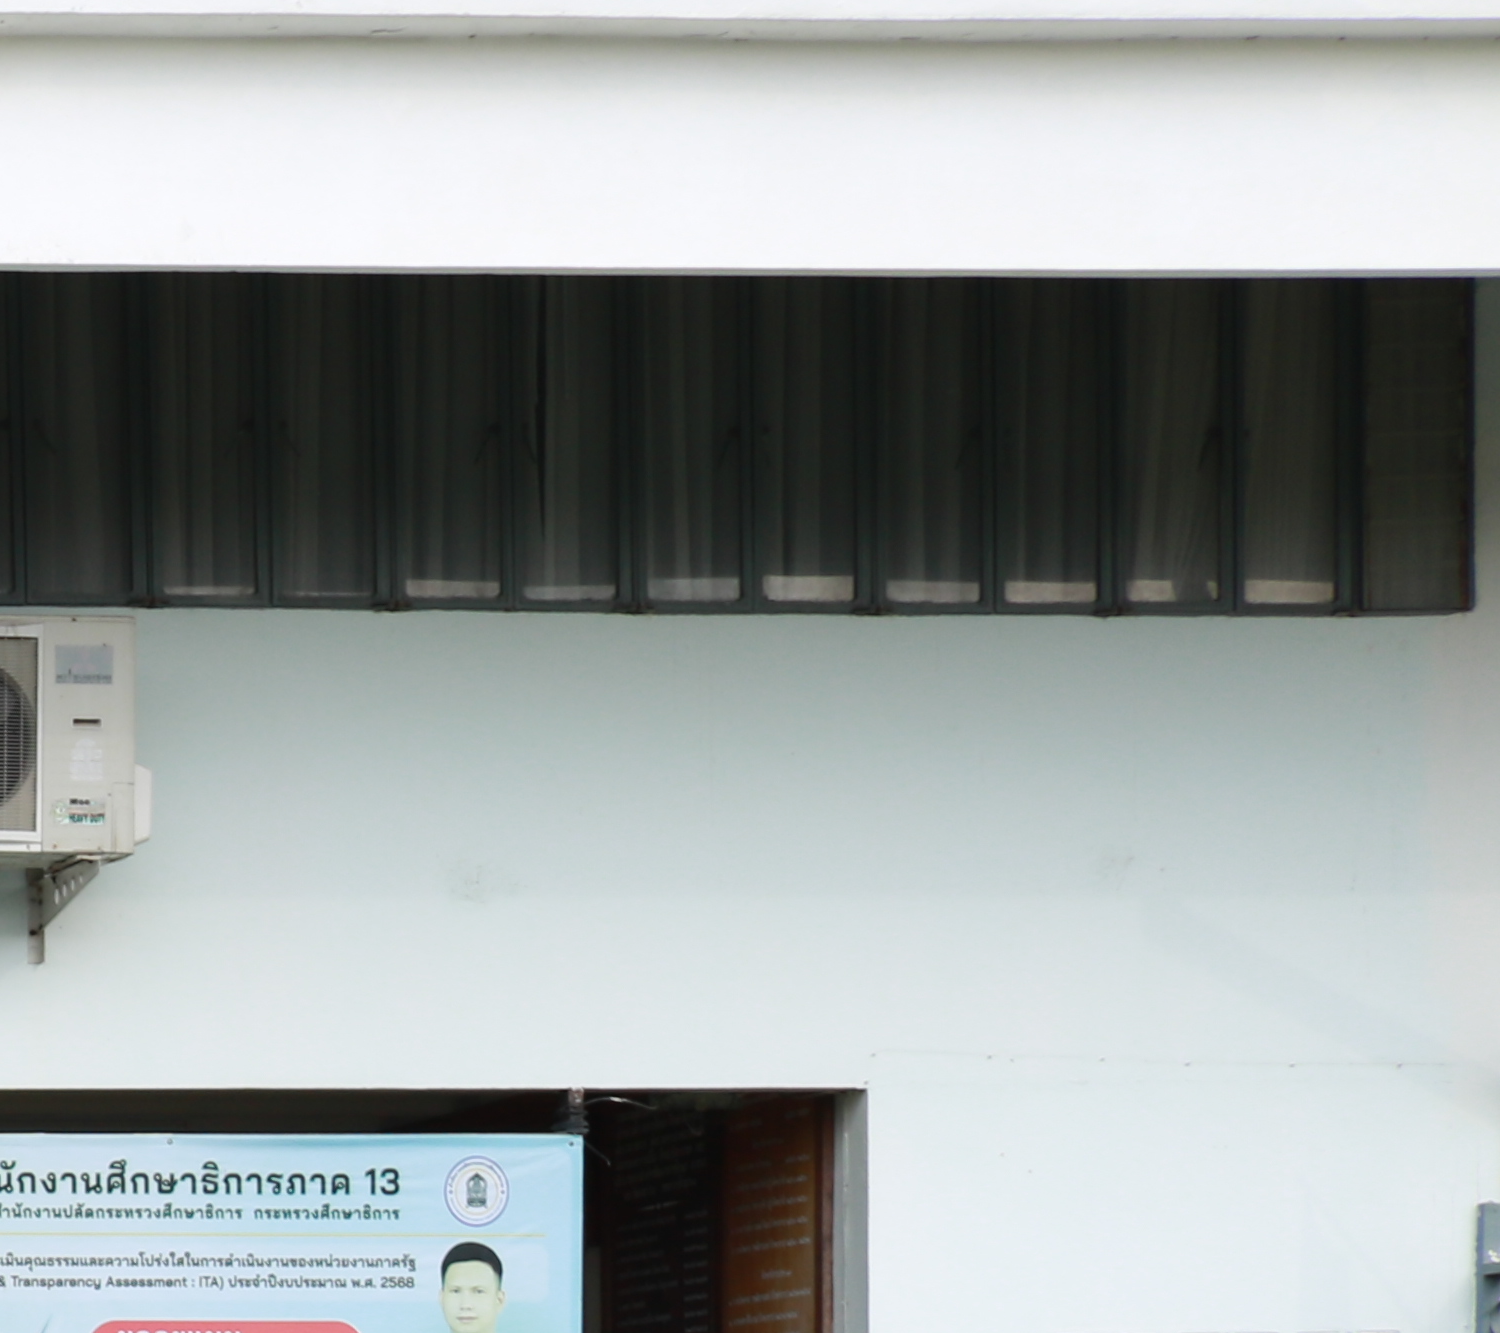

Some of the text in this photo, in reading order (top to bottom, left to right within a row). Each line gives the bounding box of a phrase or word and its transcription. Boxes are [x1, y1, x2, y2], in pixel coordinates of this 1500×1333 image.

[365, 1168, 400, 1195] 13
[253, 1202, 400, 1220] กระทรวงศึกษาธิการ
[11, 1275, 101, 1290] Transparency
[105, 1275, 188, 1288] Assessment
[199, 1276, 224, 1290] ITA)
[228, 1274, 347, 1289] ประจำปีงบประมาณ
[352, 1277, 375, 1288] พ.ศ.
[381, 1276, 415, 1288] 2568
